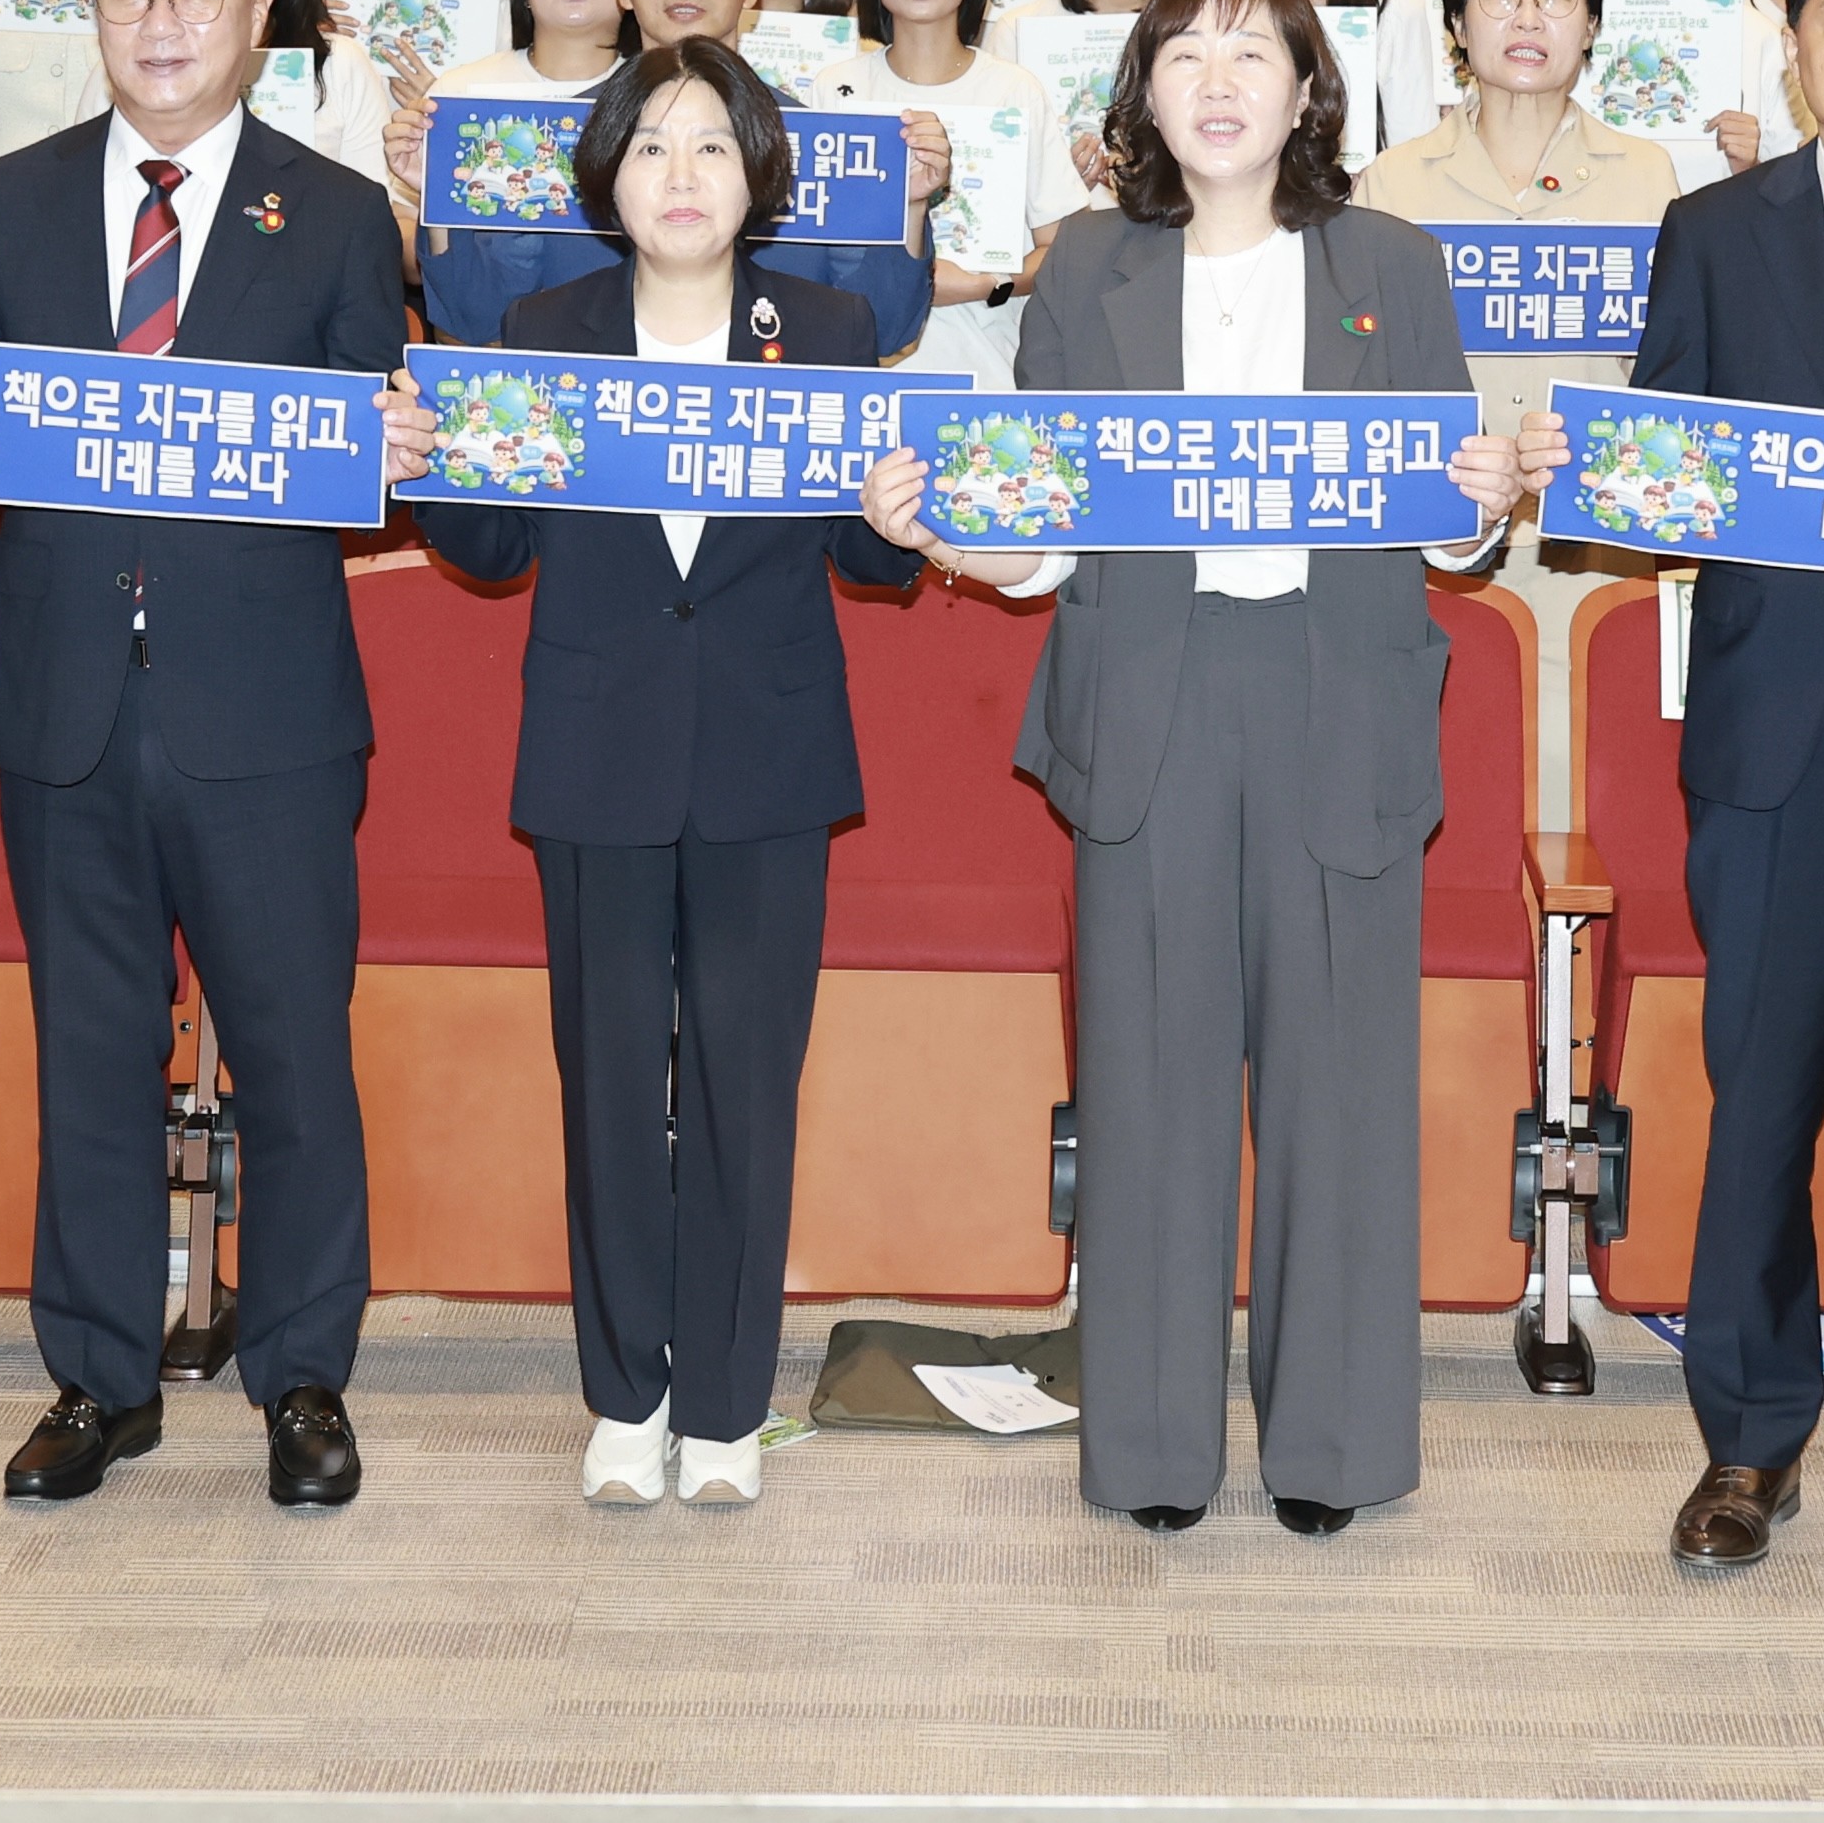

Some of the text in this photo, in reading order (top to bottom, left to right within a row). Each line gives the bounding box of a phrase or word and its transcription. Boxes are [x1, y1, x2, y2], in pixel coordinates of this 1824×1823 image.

[813, 132, 887, 182] 읽고,
[1533, 244, 1634, 292] 지구를
[1484, 293, 1586, 340] 미래를
[2, 369, 359, 462] 책으로 지구를 읽고,
[594, 378, 712, 436] 책으로
[726, 387, 846, 445] 지구를
[75, 432, 290, 505] 미래를 쓰다
[667, 442, 787, 498] 미래를
[1095, 416, 1216, 473] 책으로
[1230, 418, 1350, 475] 지구를
[1173, 476, 1387, 531] 미래를 쓰다
